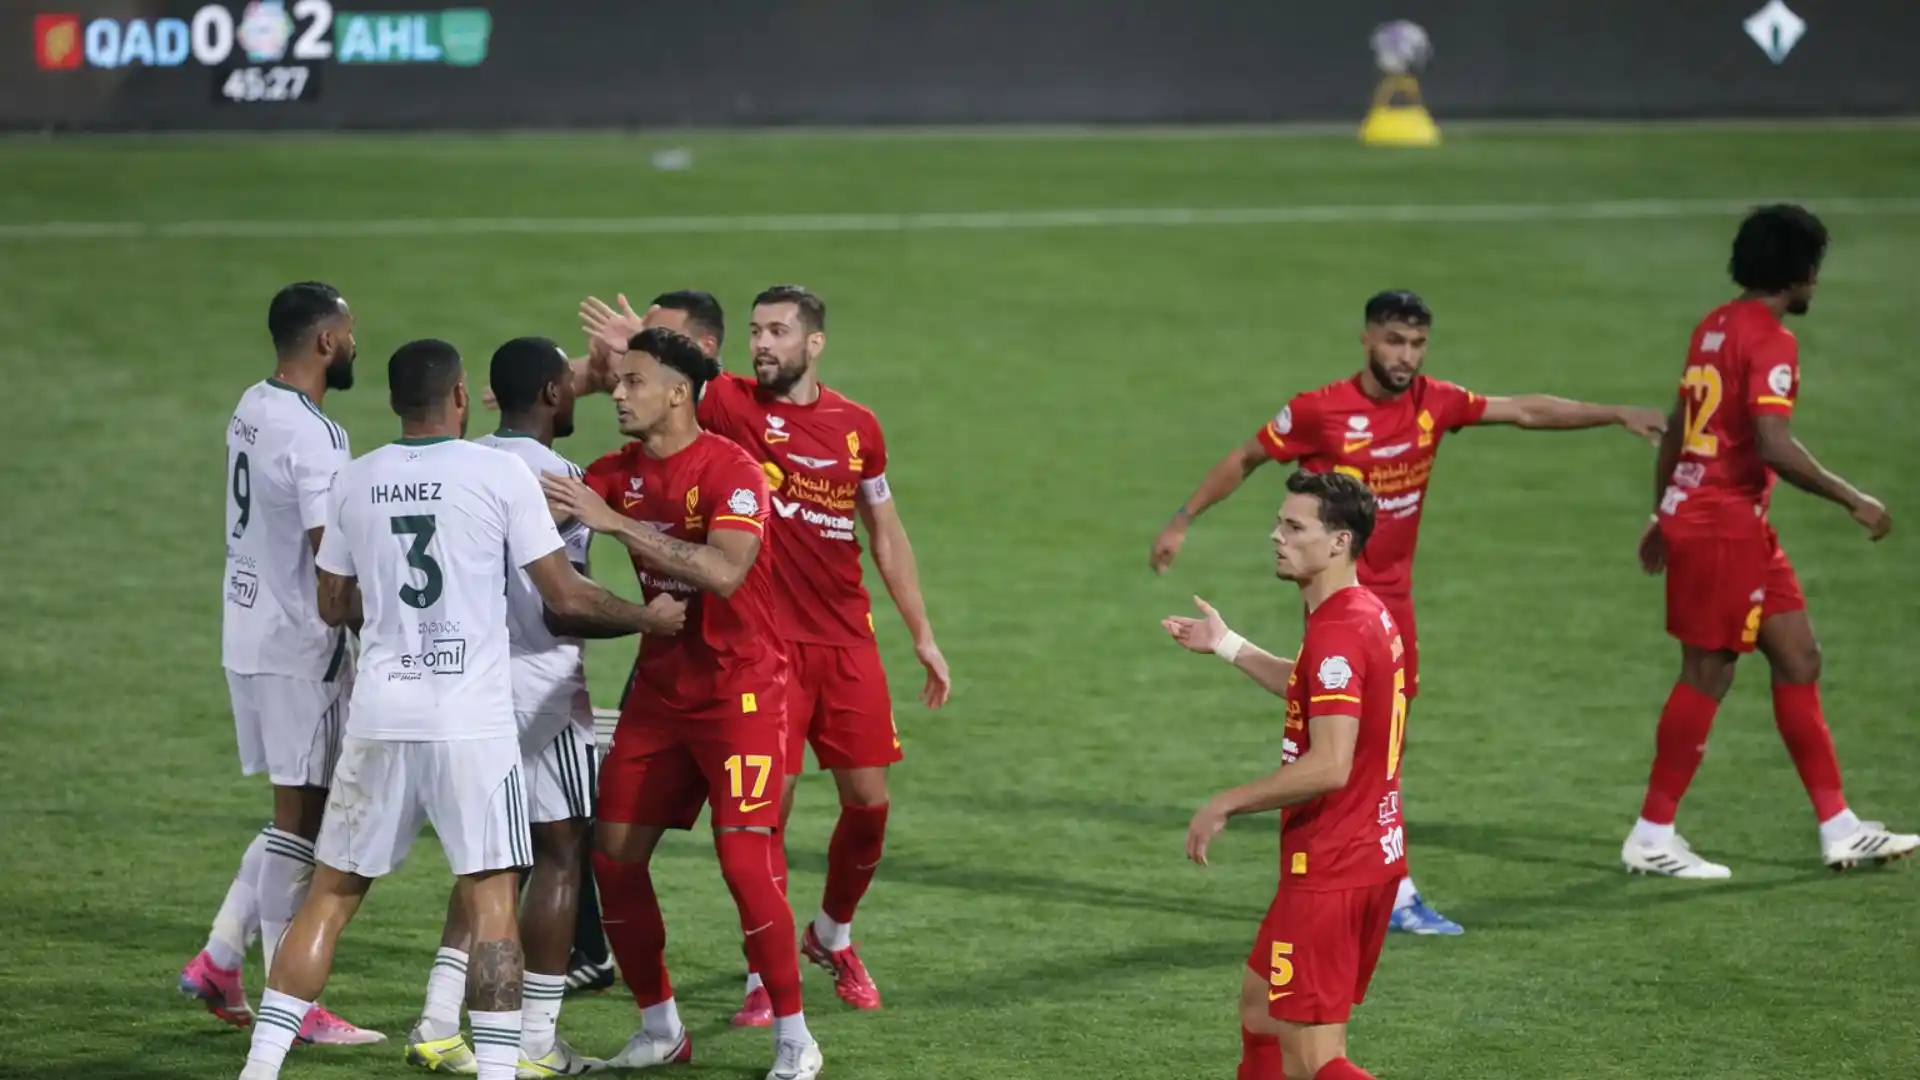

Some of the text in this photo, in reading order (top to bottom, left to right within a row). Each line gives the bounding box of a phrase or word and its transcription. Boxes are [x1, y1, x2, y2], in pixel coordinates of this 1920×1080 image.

[84, 0, 442, 67] QAD 0 2 AHL
[232, 451, 251, 539] 9
[390, 514, 443, 609] 3
[724, 754, 772, 798] 17
[1270, 940, 1294, 986] 5
